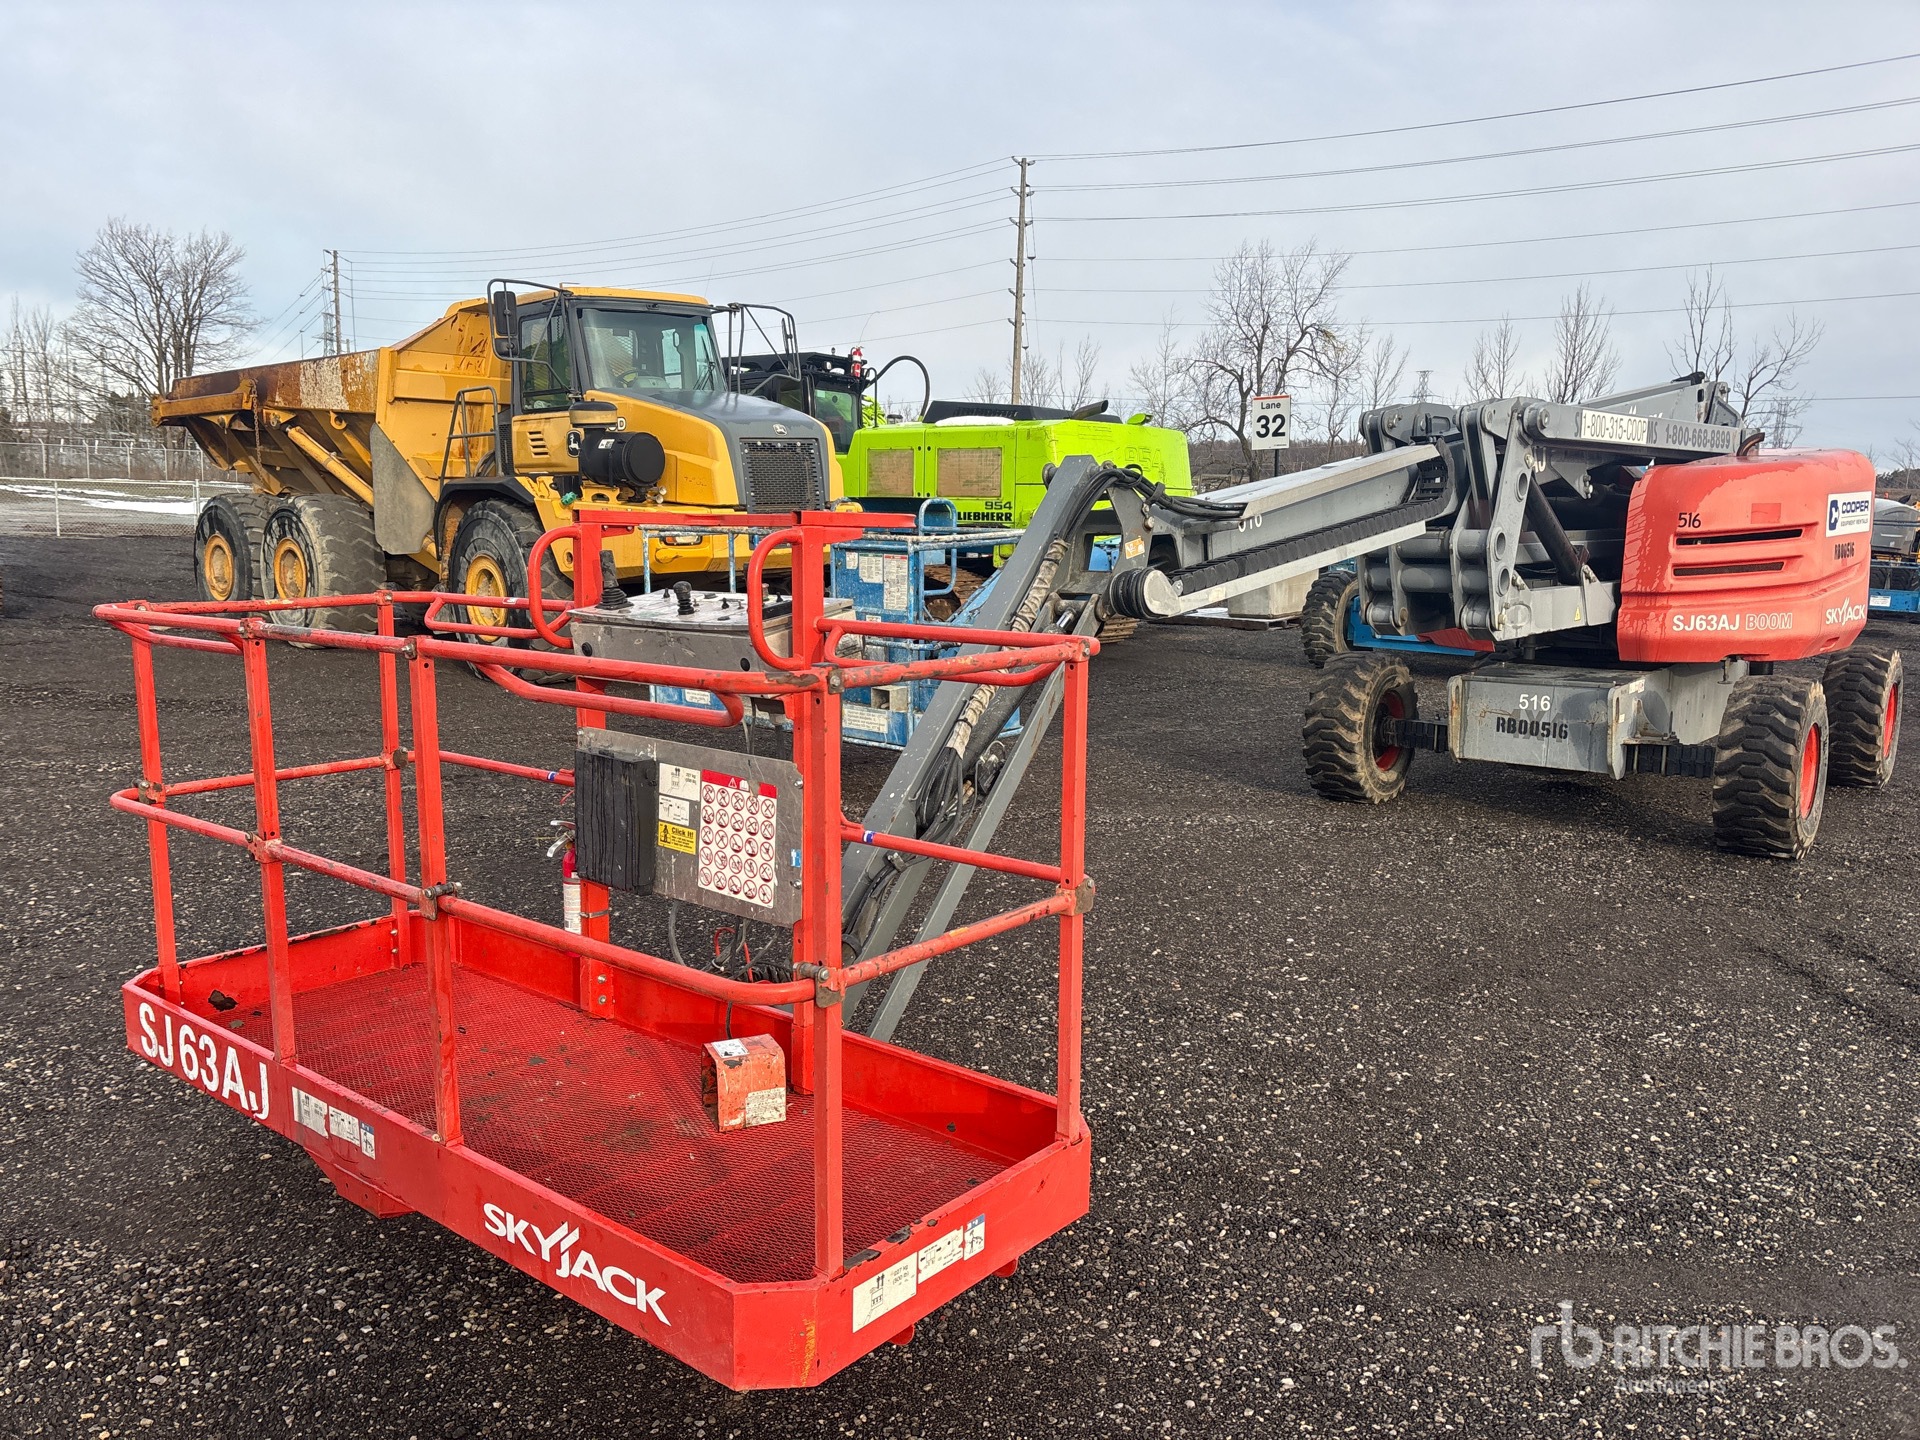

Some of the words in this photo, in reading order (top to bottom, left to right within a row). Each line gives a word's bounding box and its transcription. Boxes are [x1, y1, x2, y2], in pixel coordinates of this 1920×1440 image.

[1260, 402, 1281, 410] Lane
[1256, 414, 1286, 438] 32
[1583, 412, 1647, 442] 1-800-315-COOP
[1665, 423, 1731, 450] 1-800-668-8899
[985, 501, 1013, 510] 954
[1841, 500, 1870, 514] COOPER
[957, 511, 1013, 522] LIEBHERR
[1678, 512, 1702, 529] 516
[1834, 541, 1855, 560] RB00516
[1825, 597, 1866, 626] SKYJACK
[1672, 614, 1740, 631] SJ63AJ
[1745, 613, 1793, 631] BOOM
[1519, 693, 1551, 711] 516
[1496, 716, 1568, 740] RB00516
[671, 826, 686, 837] Click
[139, 1002, 270, 1120] SJ63AJ
[483, 1203, 672, 1327] SKYJACK
